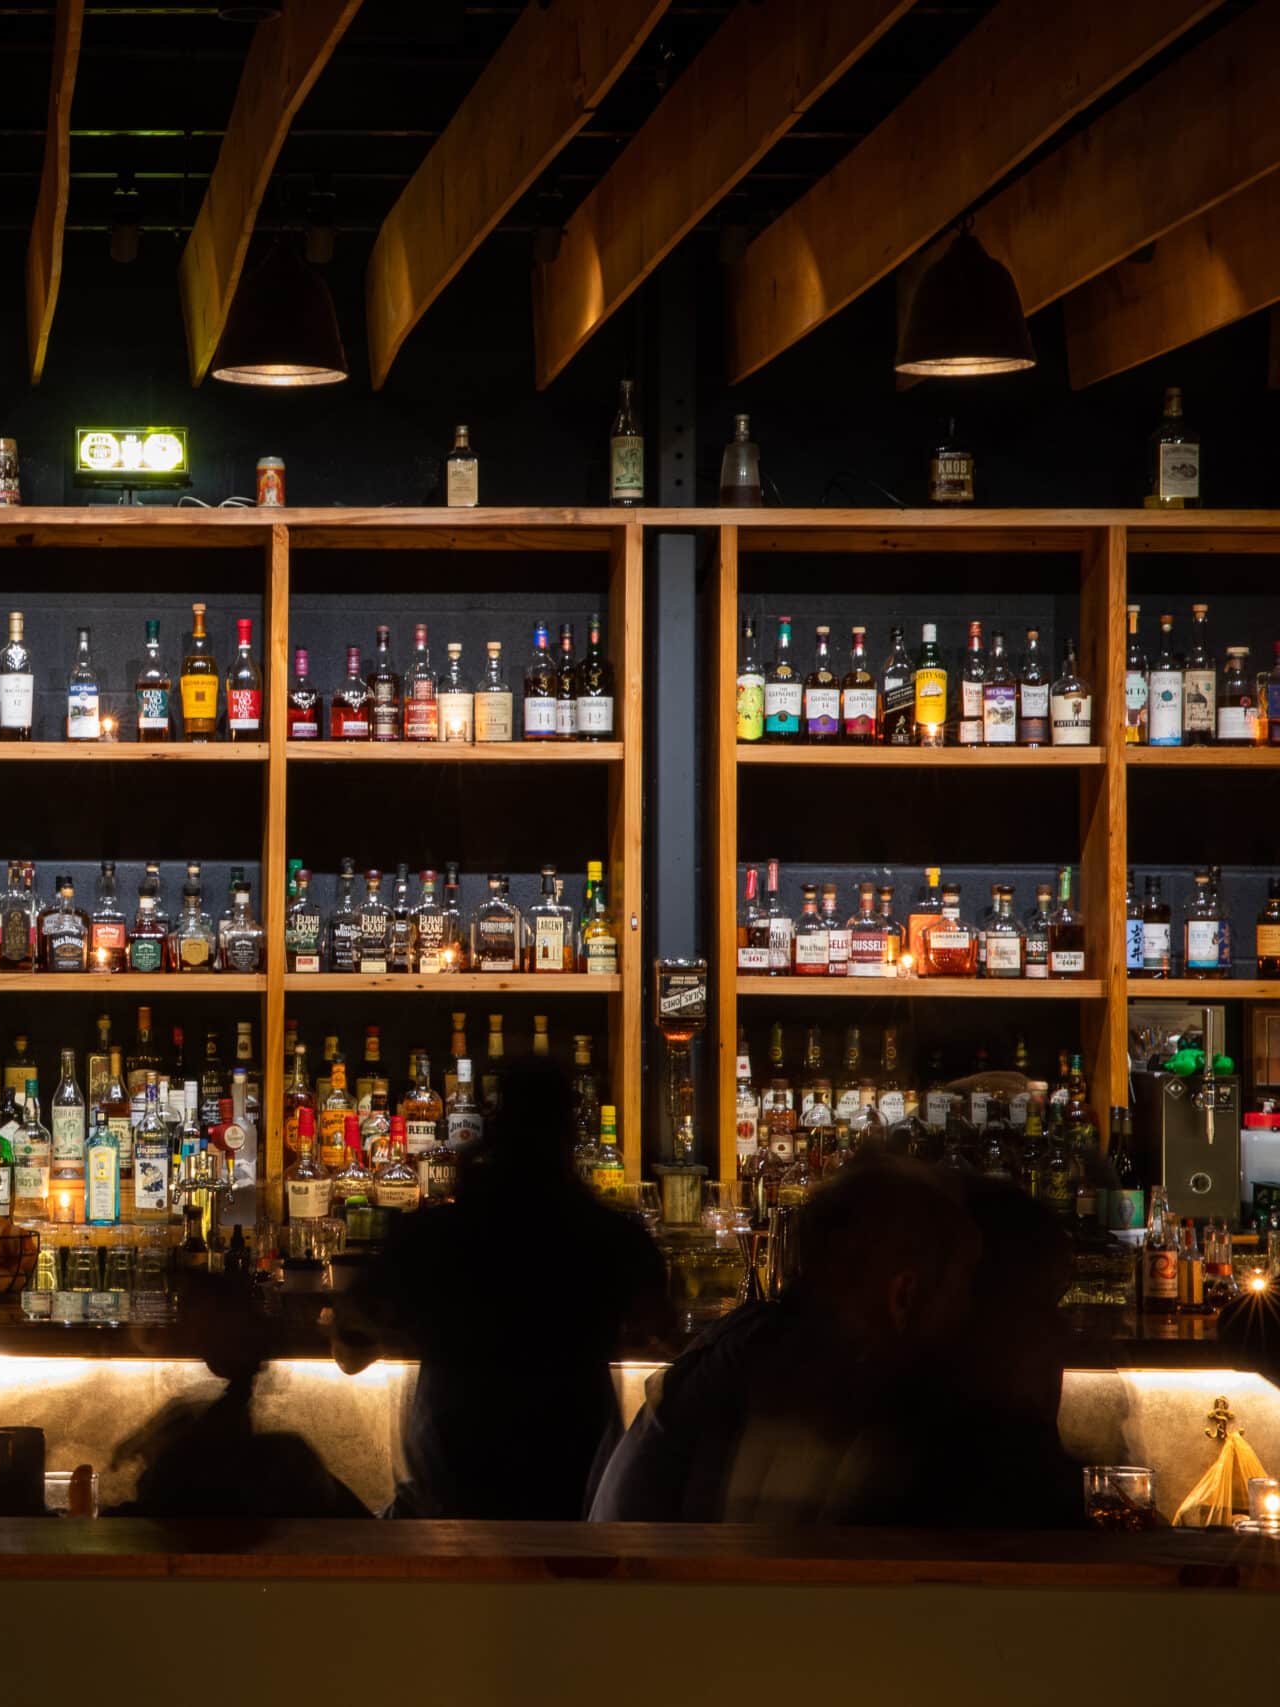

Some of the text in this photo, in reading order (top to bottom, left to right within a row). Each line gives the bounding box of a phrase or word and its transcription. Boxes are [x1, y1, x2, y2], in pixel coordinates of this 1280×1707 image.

[938, 460, 967, 473] KNOB
[232, 690, 251, 698] GLEN
[296, 914, 320, 923] ELIJAH
[362, 914, 386, 923] ELIJAH
[420, 914, 444, 923] ELIJAH
[296, 923, 319, 932] CRAIG
[361, 922, 386, 932] CRAIG
[419, 922, 443, 932] CRAIG
[408, 1125, 435, 1134] REBE
